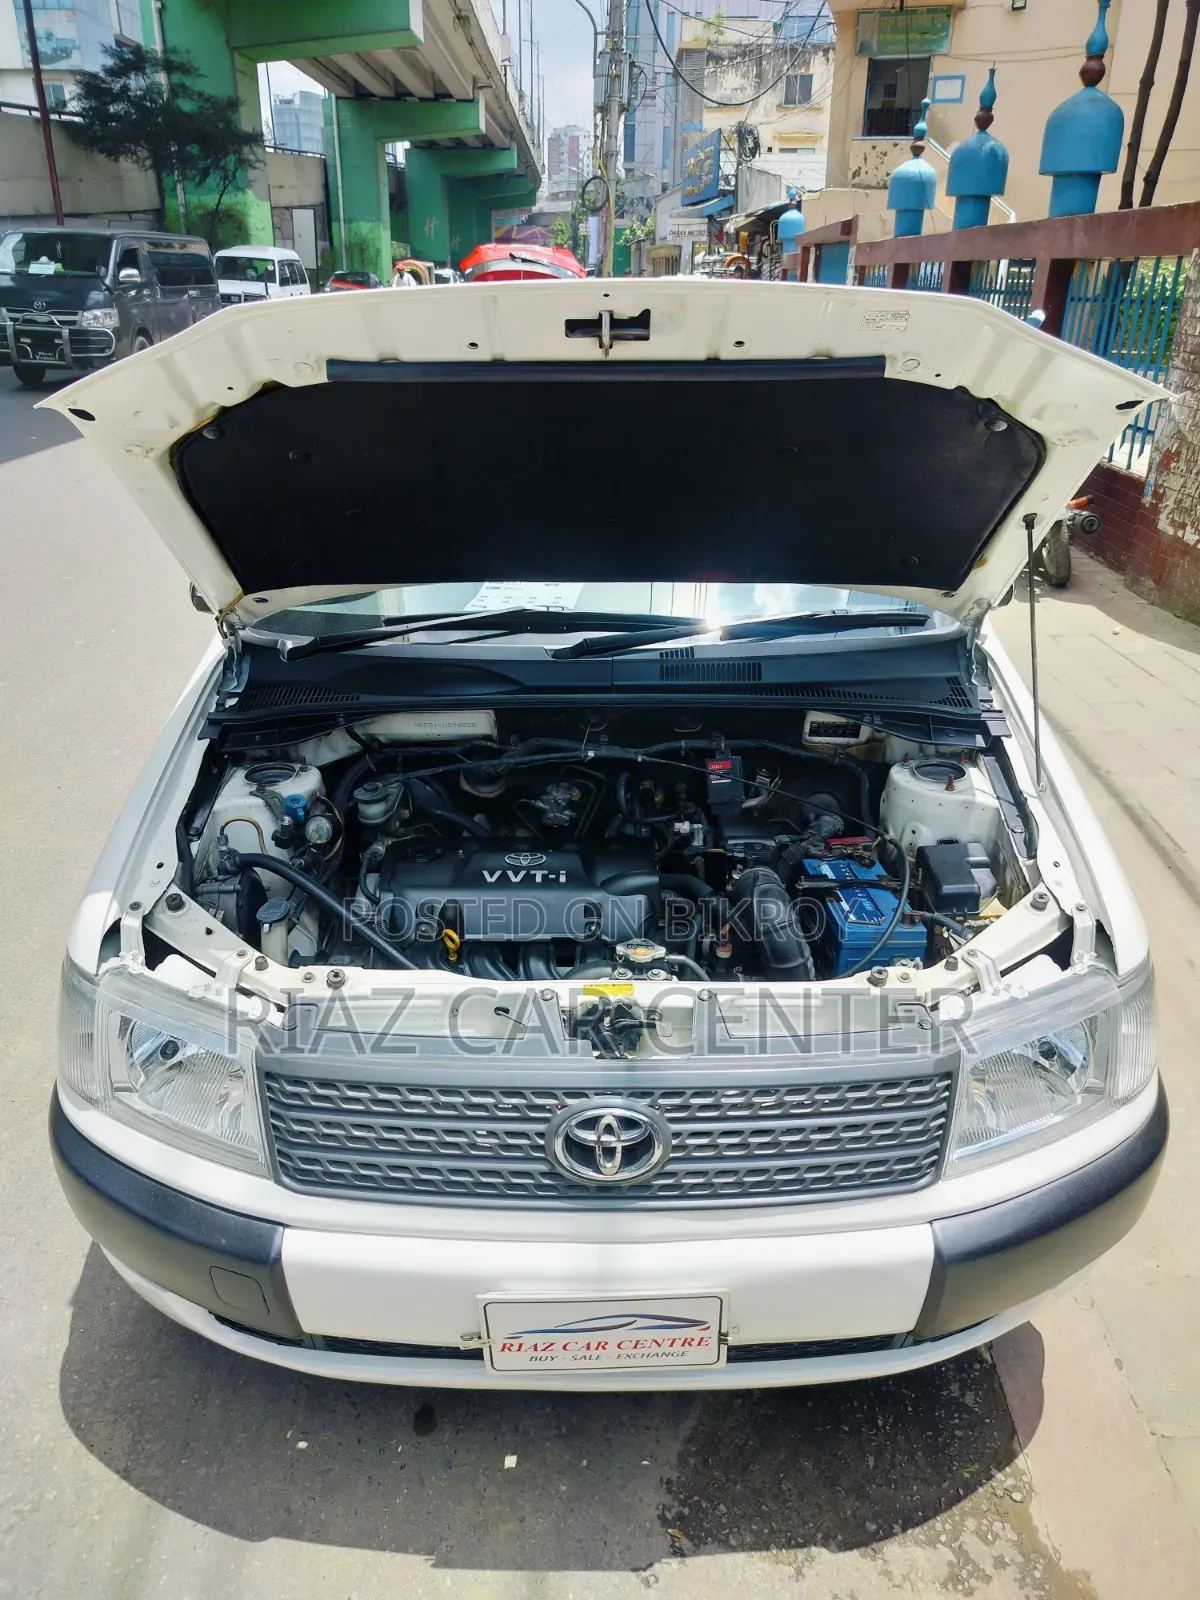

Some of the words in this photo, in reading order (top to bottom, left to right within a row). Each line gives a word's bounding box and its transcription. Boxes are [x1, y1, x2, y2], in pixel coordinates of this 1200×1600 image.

[482, 870, 566, 882] VVT-i
[499, 1341, 556, 1353] RIAZ
[562, 1341, 609, 1351] CAR
[616, 1335, 711, 1350] CENTRE
[571, 1353, 603, 1362] SALE
[616, 1350, 689, 1360] EXCHANGE
